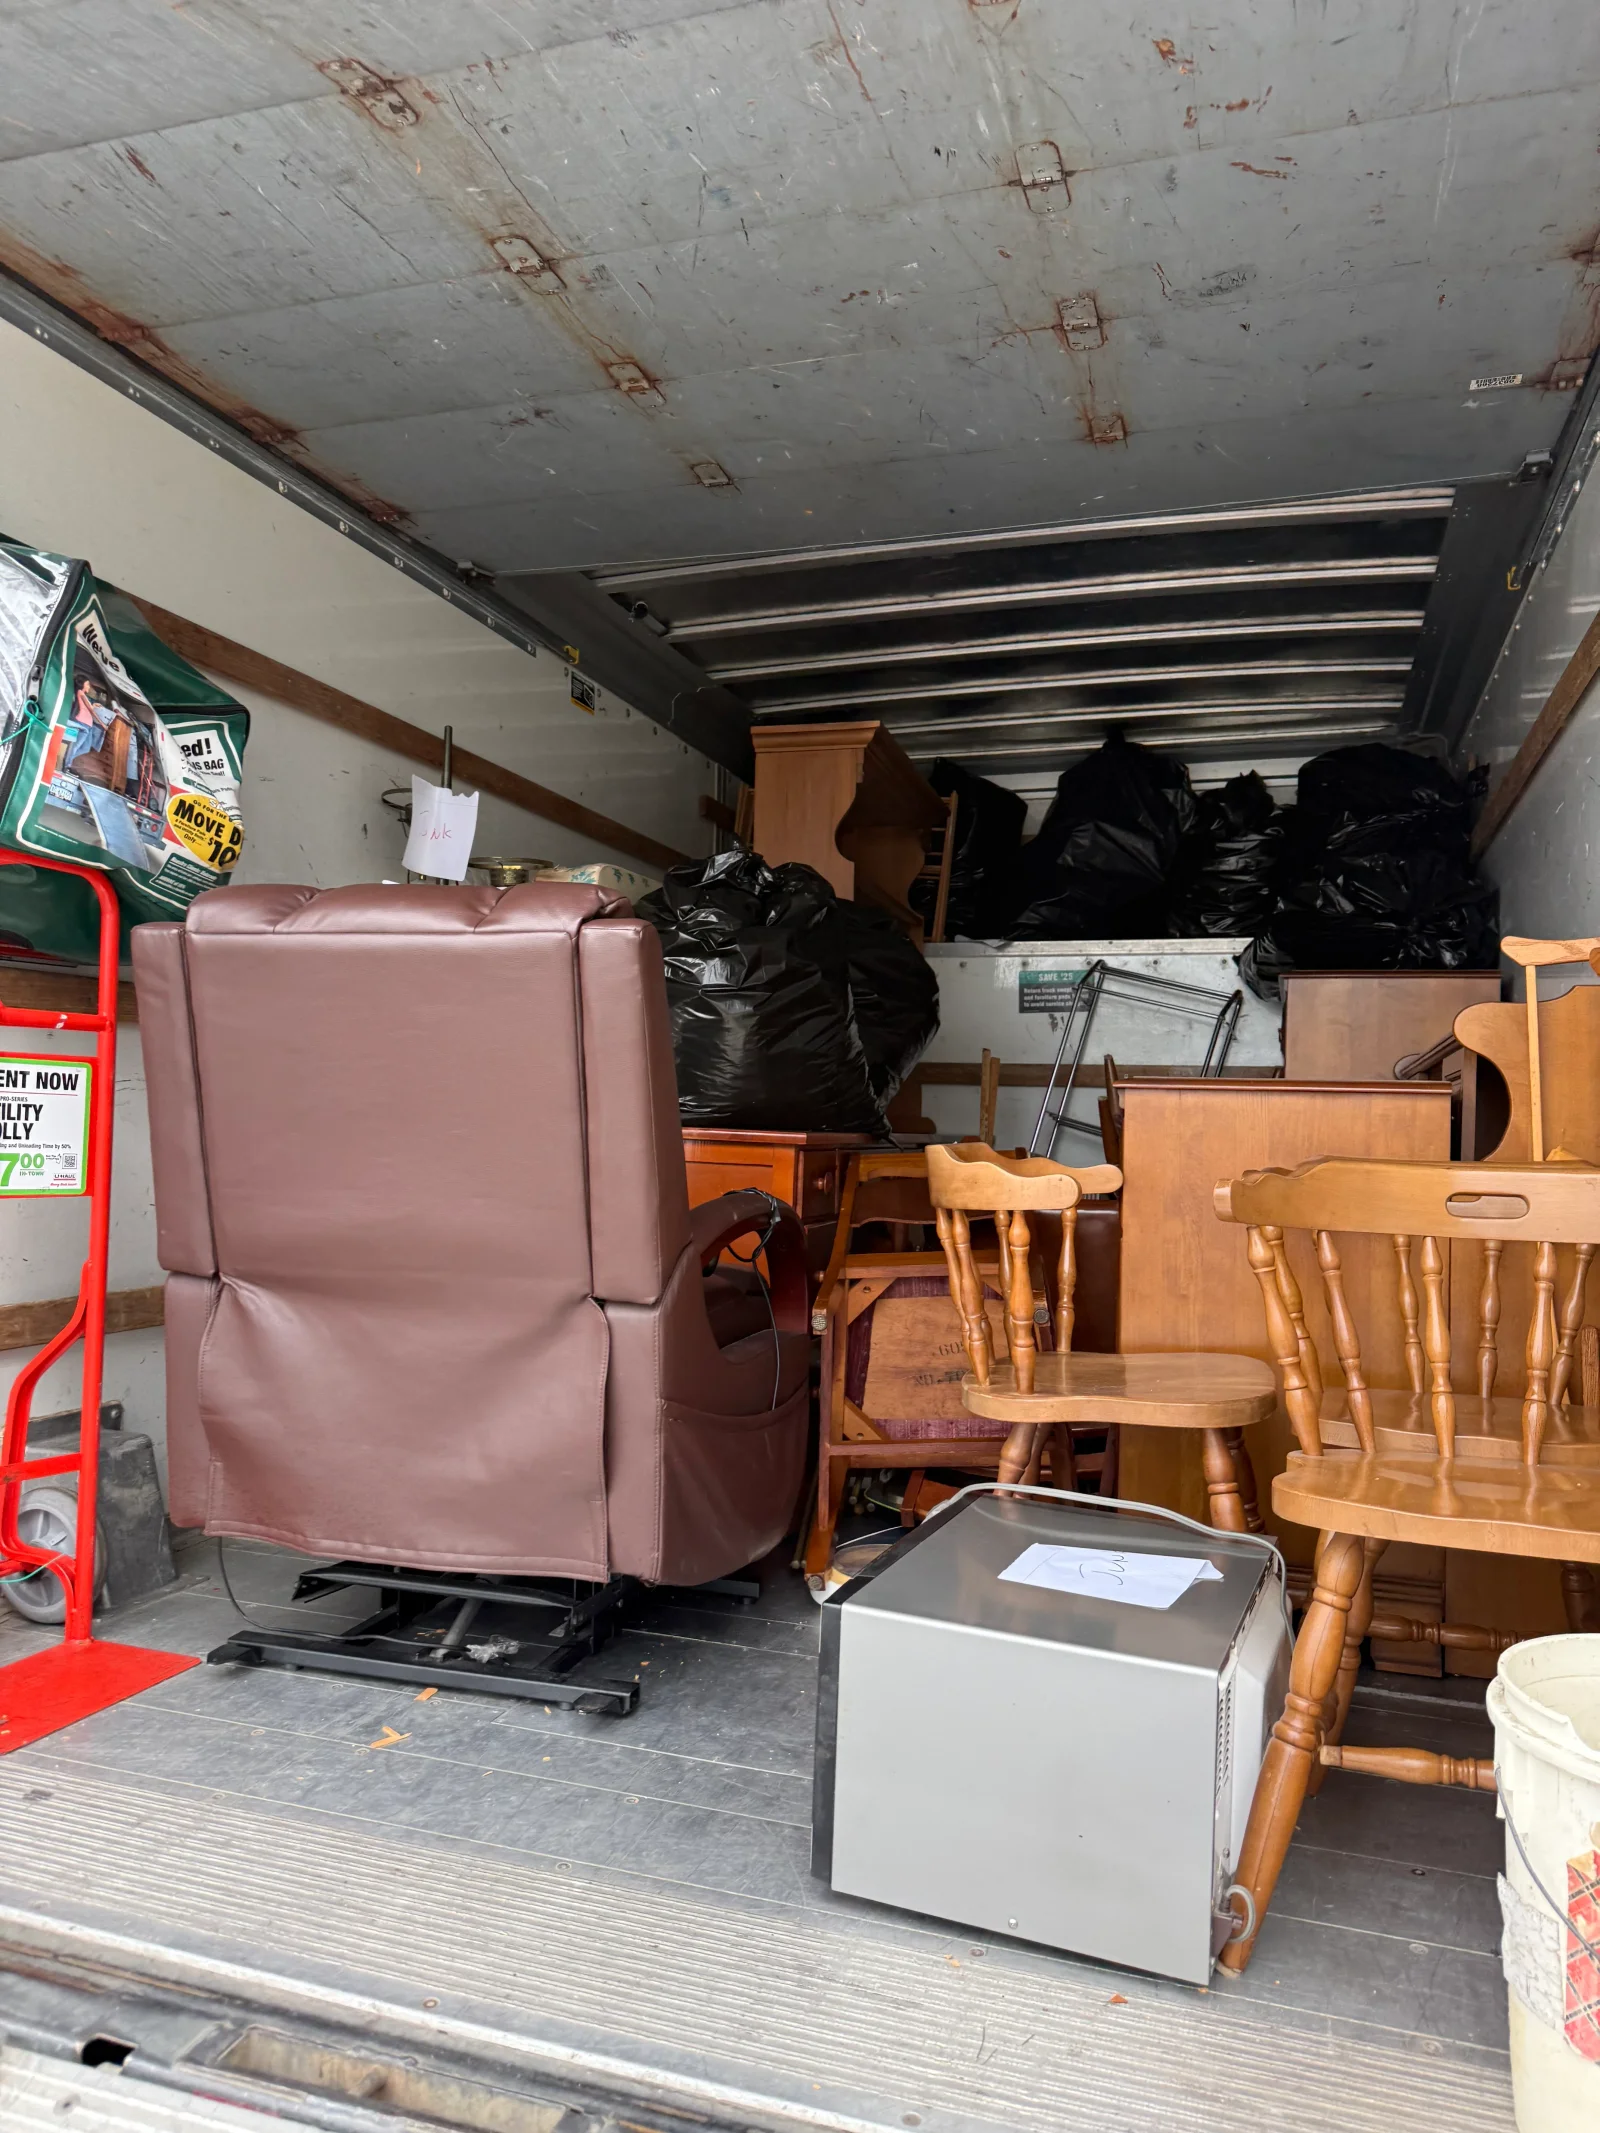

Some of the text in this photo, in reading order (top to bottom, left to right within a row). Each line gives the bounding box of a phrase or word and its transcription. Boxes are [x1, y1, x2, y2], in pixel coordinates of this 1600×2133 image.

[180, 738, 212, 757] ed!
[203, 758, 224, 770] BAG
[203, 805, 214, 814] FOR
[216, 811, 227, 819] THE
[173, 799, 242, 847] MOVE D
[1038, 973, 1058, 981] SAVE
[0, 1069, 79, 1091] ENT NOW
[0, 1103, 43, 1121] ILITY
[0, 1122, 34, 1140] LLY
